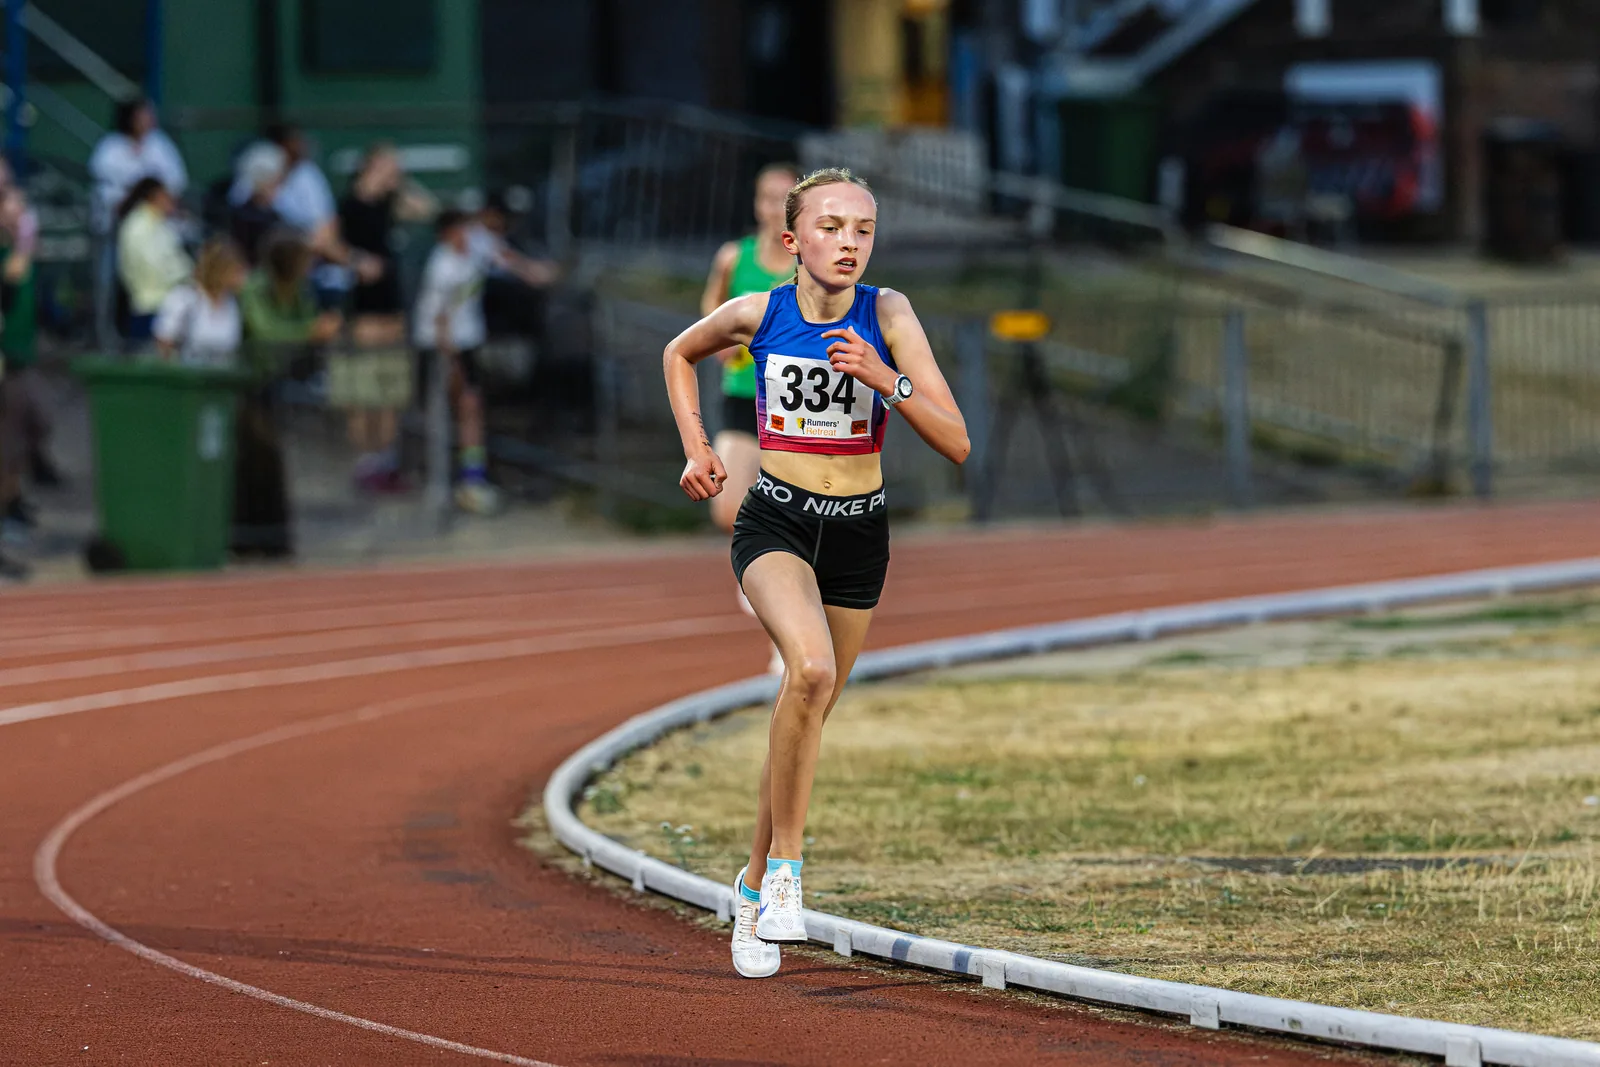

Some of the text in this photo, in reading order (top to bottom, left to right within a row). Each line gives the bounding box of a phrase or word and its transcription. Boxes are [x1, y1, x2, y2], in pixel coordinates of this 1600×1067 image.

[780, 364, 857, 415] 334
[805, 427, 837, 437] Retreat
[802, 496, 867, 517] NIKE
